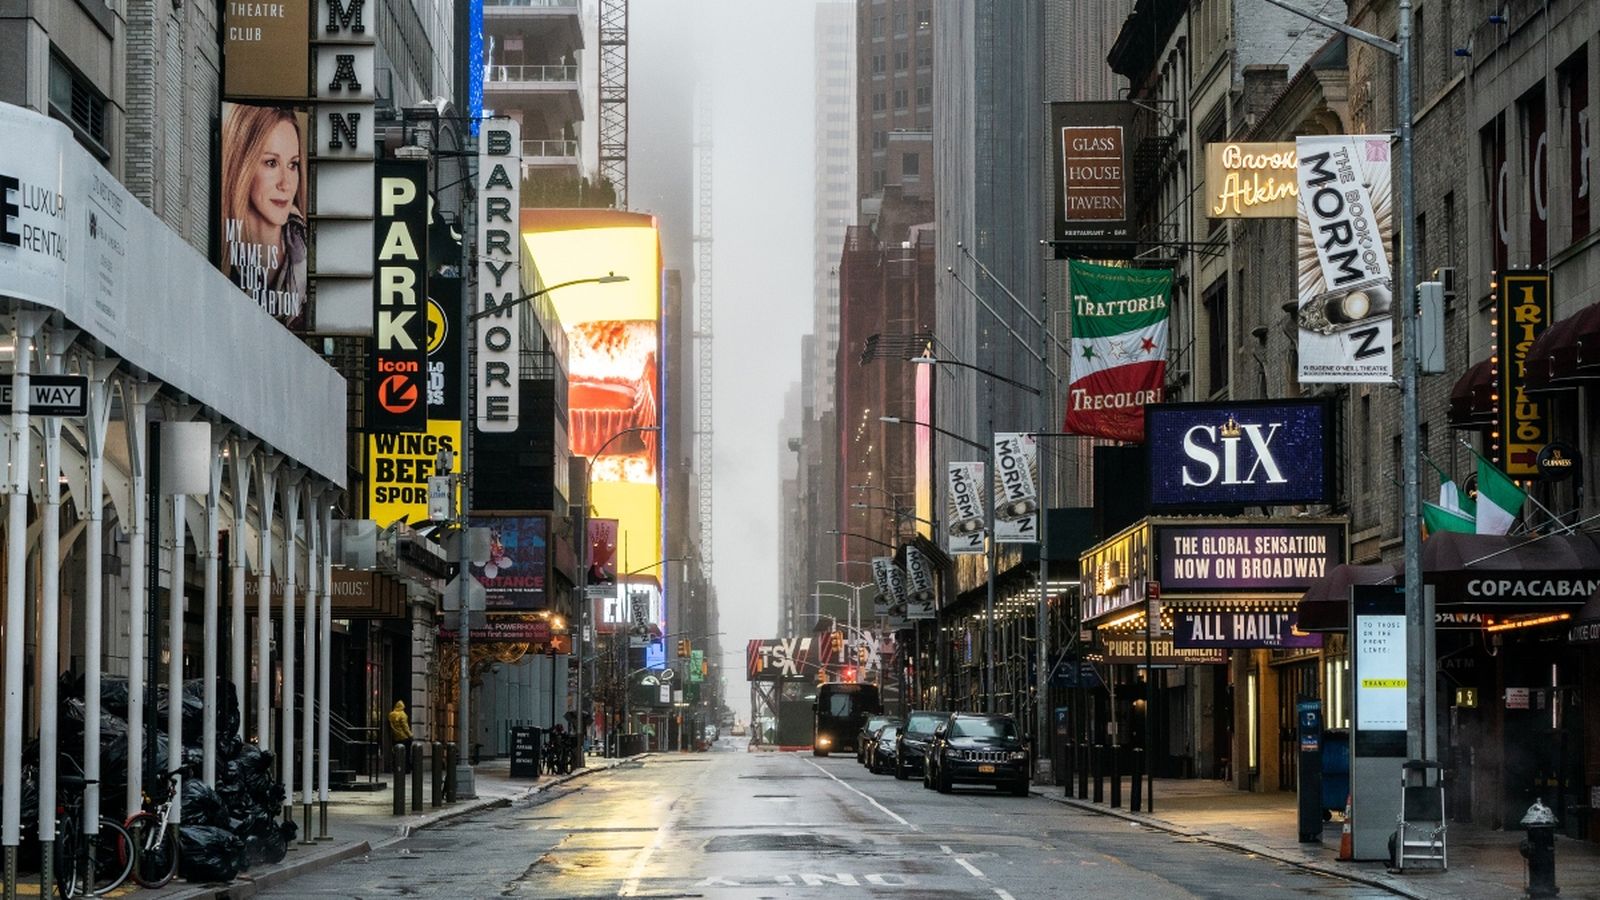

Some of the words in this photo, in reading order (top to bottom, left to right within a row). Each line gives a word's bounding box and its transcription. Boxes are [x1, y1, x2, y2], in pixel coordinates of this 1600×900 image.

[231, 2, 285, 18] THEATRE
[230, 27, 262, 41] CLUB
[1072, 137, 1114, 151] GLASS
[1069, 166, 1121, 180] HOUSE
[1067, 195, 1123, 209] TAVERN
[1214, 172, 1298, 215] Atkin
[1333, 146, 1355, 184] THE
[1345, 189, 1372, 249] BOOK
[226, 218, 243, 243] MY
[230, 241, 262, 267] NAME
[267, 244, 279, 270] IS
[378, 176, 419, 350] PARK
[1301, 151, 1385, 361] MORMN
[240, 264, 269, 291] LUCY
[484, 130, 513, 421] BARRYMORE
[1074, 293, 1166, 316] TRATTORIA
[378, 357, 418, 372] icon
[36, 387, 76, 403] WAY
[375, 433, 458, 456] WINGS.
[1182, 422, 1288, 487] SIX
[1542, 458, 1572, 467] GUINNESS
[996, 439, 1034, 533] MORMN
[950, 468, 982, 546] MORMN
[1174, 536, 1198, 555] THE
[1202, 536, 1251, 555] GLOBAL
[1255, 535, 1327, 554] SENSATION
[1174, 558, 1209, 579] NOW
[1216, 558, 1237, 579] ON
[1241, 557, 1327, 579] BROADWAY
[1186, 614, 1225, 640] "ALL
[1233, 614, 1289, 640] HAIL!"
[758, 638, 798, 675] TSX
